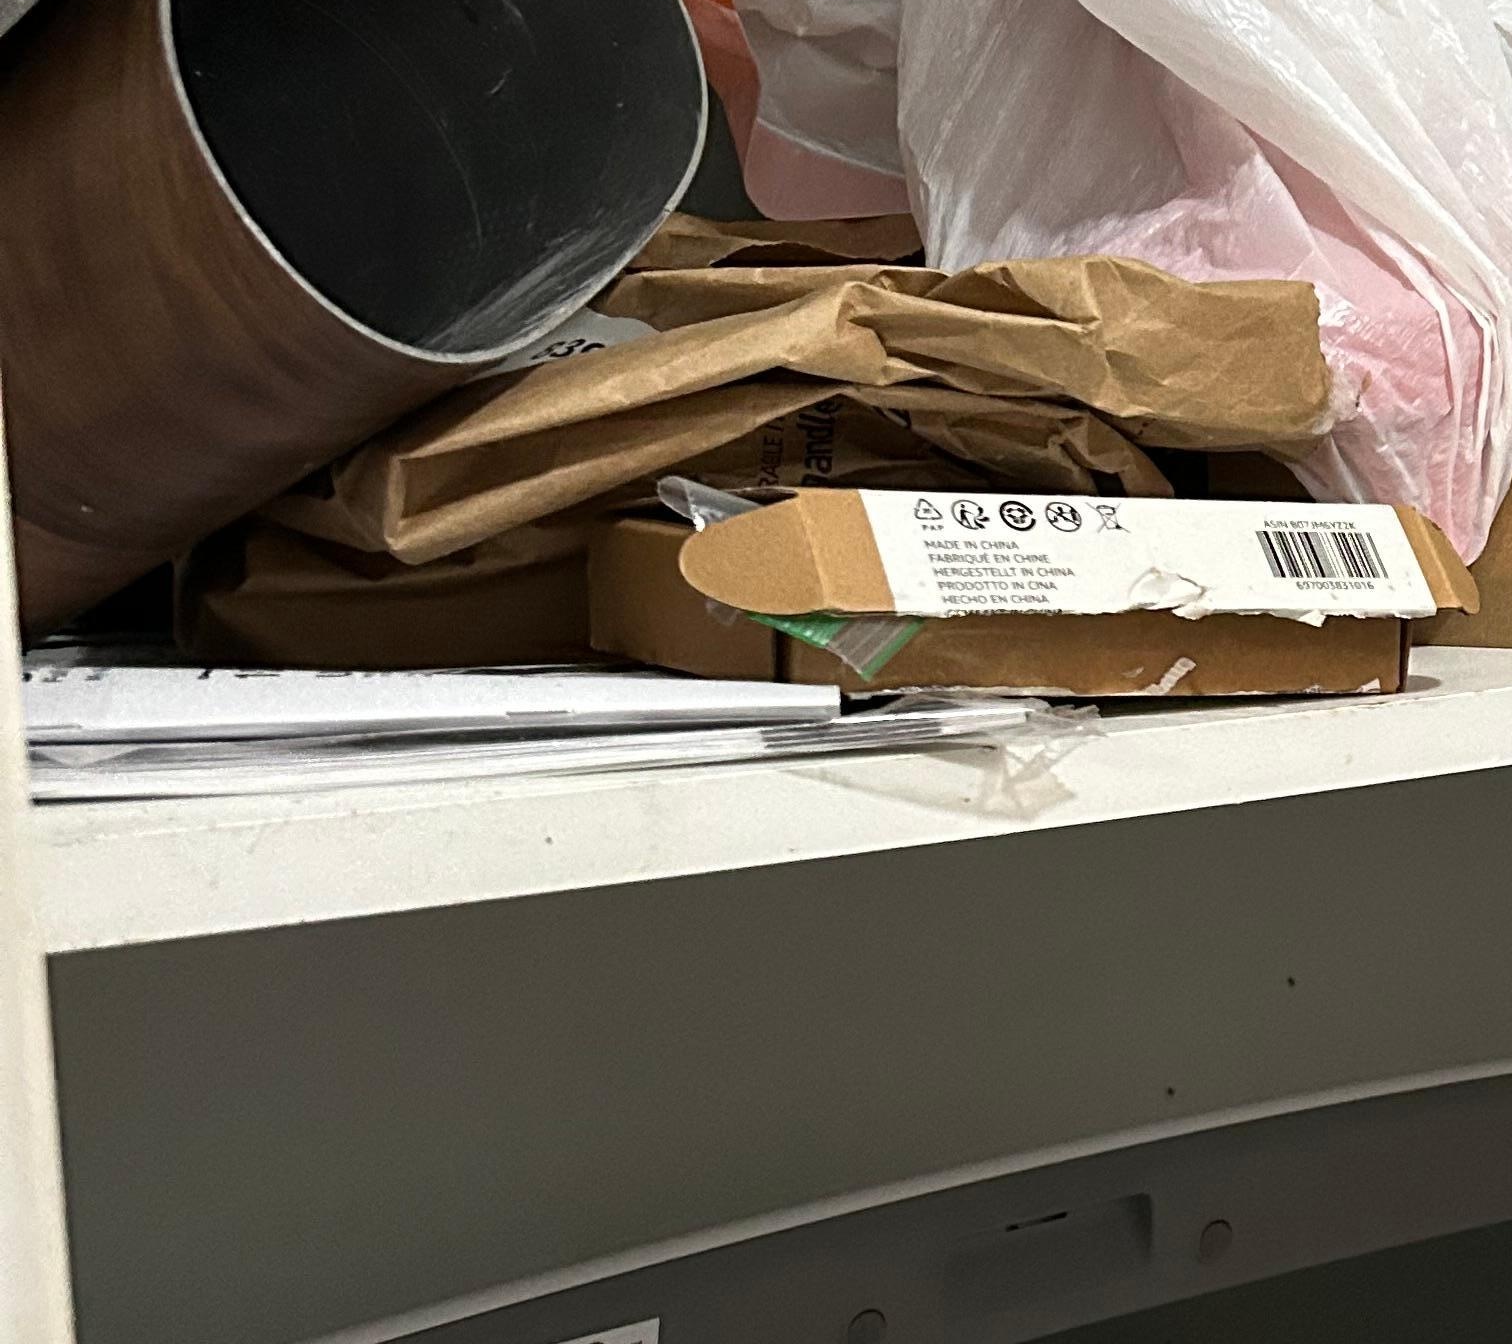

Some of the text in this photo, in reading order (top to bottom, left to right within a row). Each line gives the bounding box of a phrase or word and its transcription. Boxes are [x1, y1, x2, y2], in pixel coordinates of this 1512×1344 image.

[1263, 520, 1289, 530] ASIN
[923, 540, 1019, 550] MADE IN CHINA
[993, 553, 1011, 563] EN
[1014, 553, 1051, 564] CHINE
[932, 566, 1076, 577] HERGESTELLT IN CHINA
[936, 581, 1058, 591] PRODOTTO IN CINA
[941, 595, 1050, 605] HECHO EN CHINA
